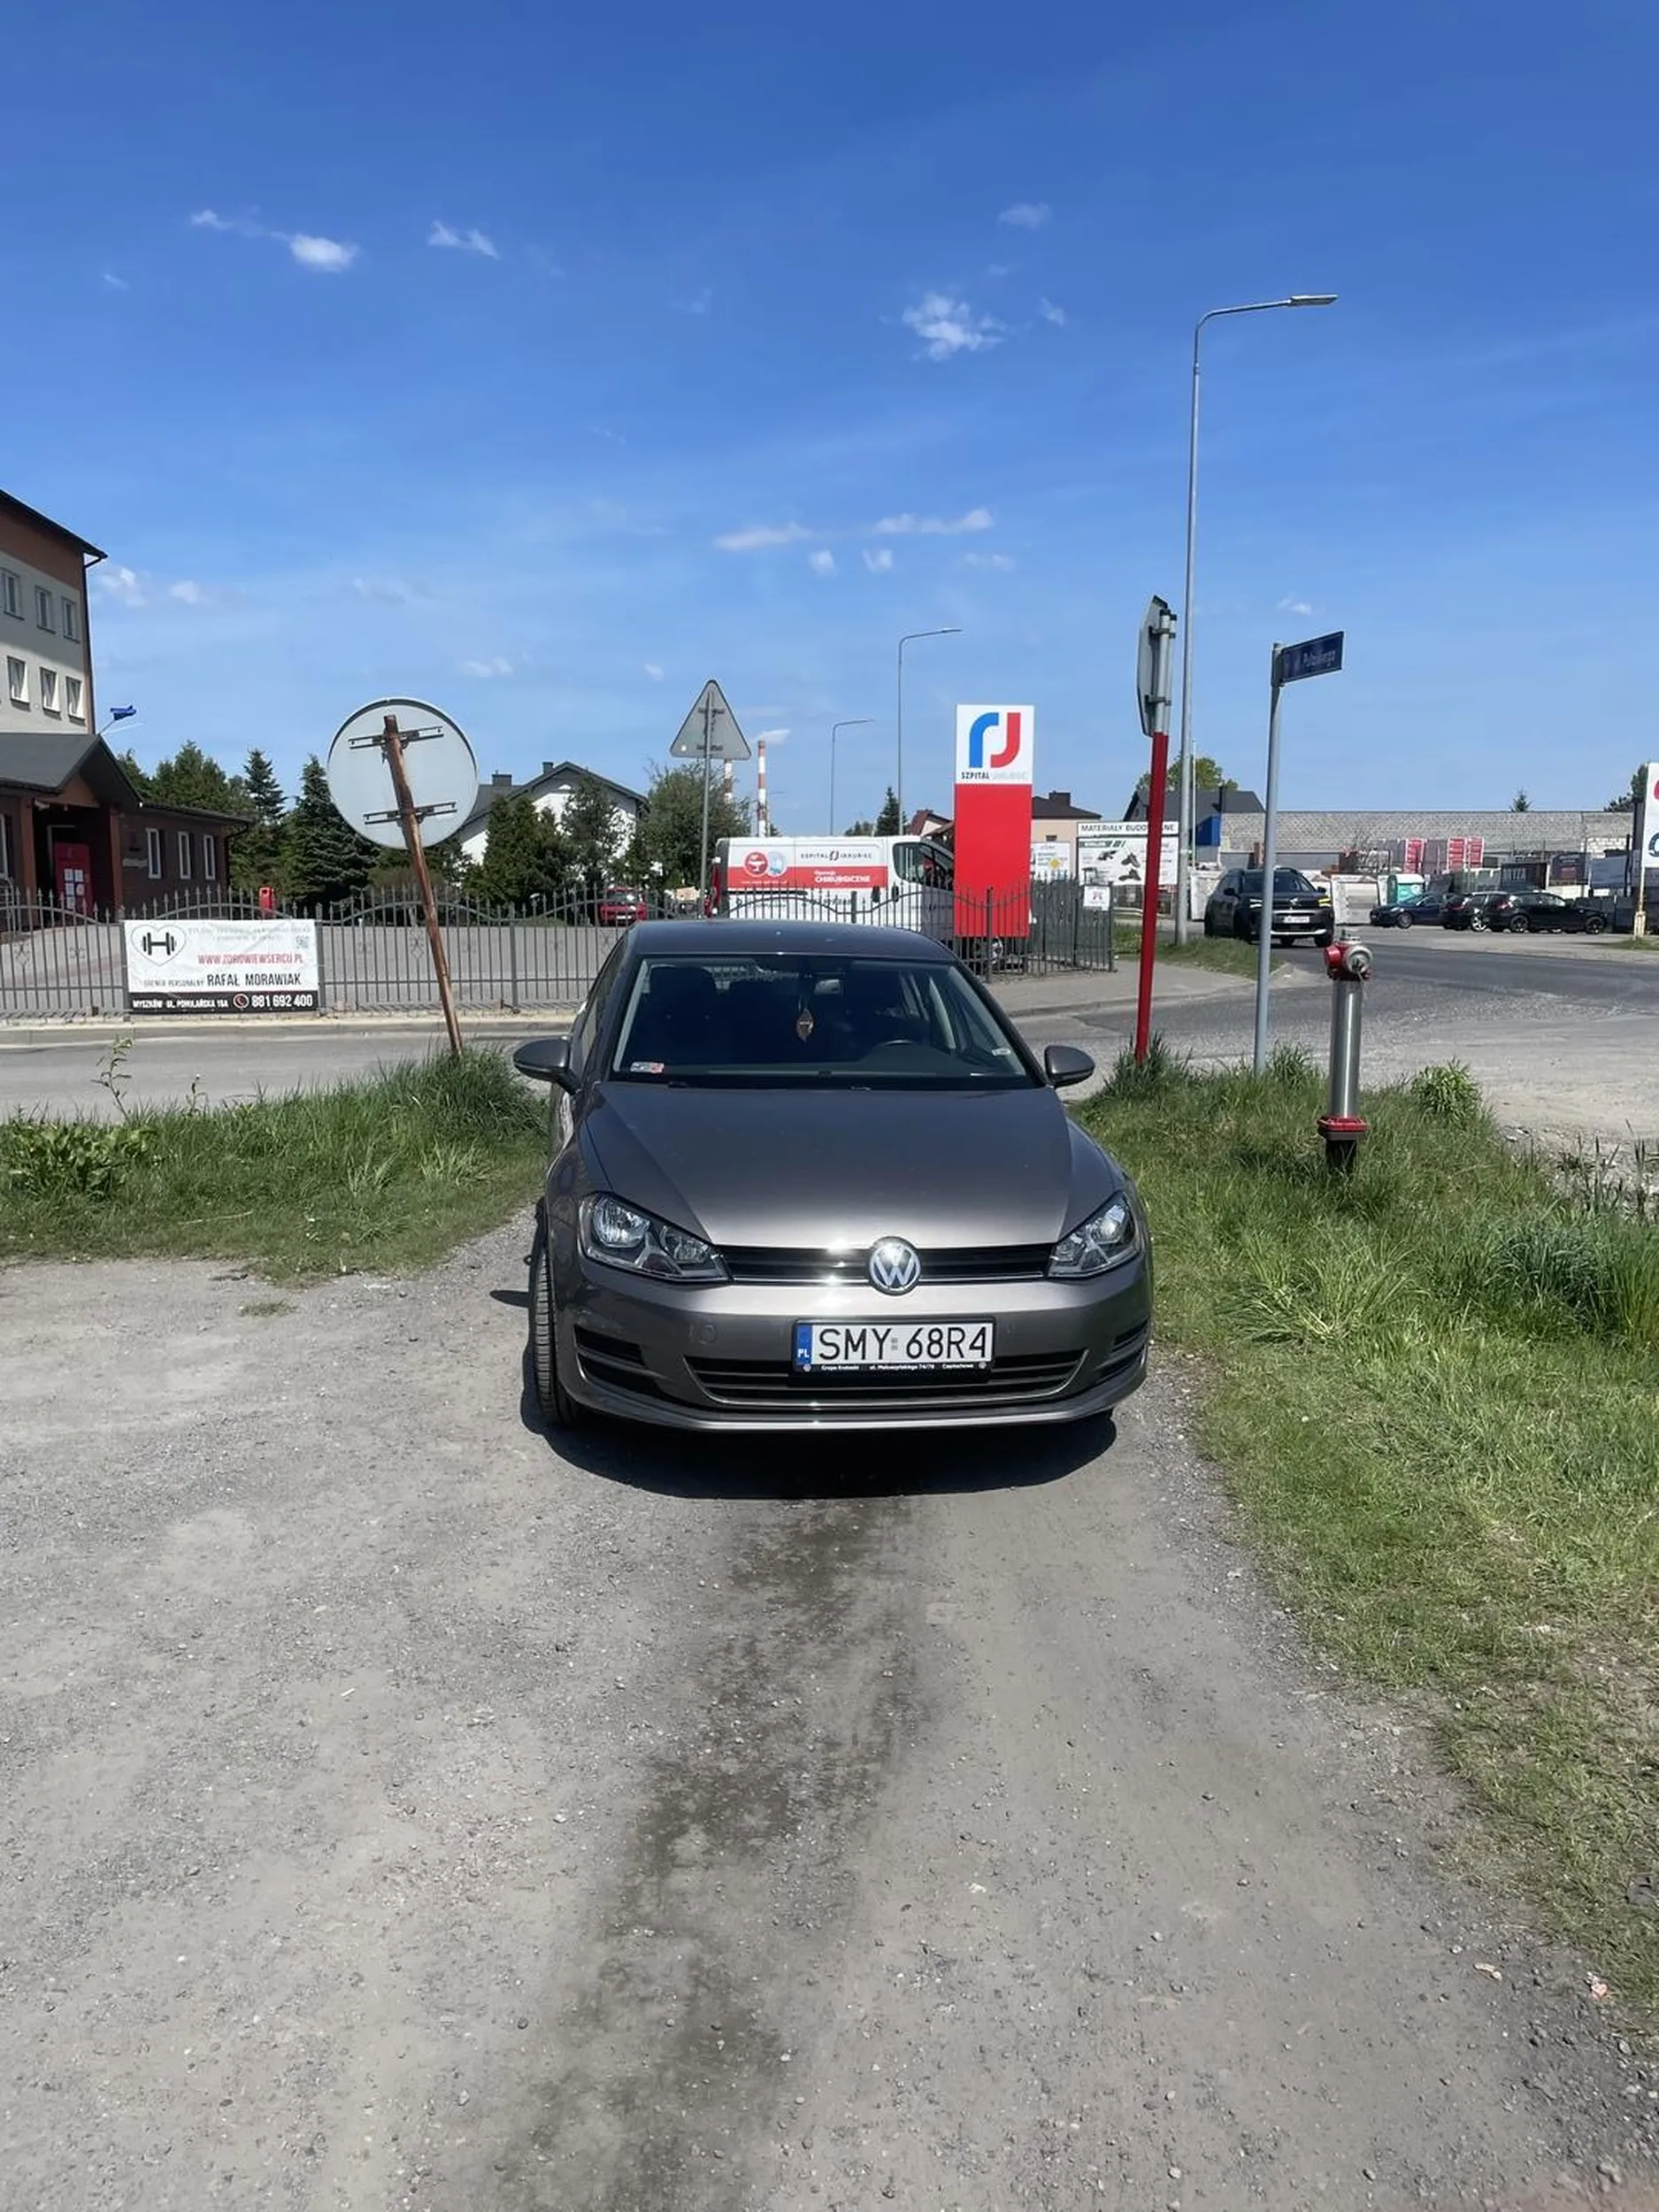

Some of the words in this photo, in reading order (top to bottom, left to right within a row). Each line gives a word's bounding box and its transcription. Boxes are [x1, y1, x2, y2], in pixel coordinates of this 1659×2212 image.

[1125, 824, 1175, 833] BUDONE
[207, 973, 240, 987] RAFAŁ
[245, 972, 301, 986] MORAWIAK
[251, 995, 271, 1008] 881
[273, 995, 292, 1007] 692
[295, 995, 312, 1007] 400
[818, 1328, 892, 1361] SMY
[906, 1326, 987, 1359] 68R4
[797, 1348, 810, 1357] PL
